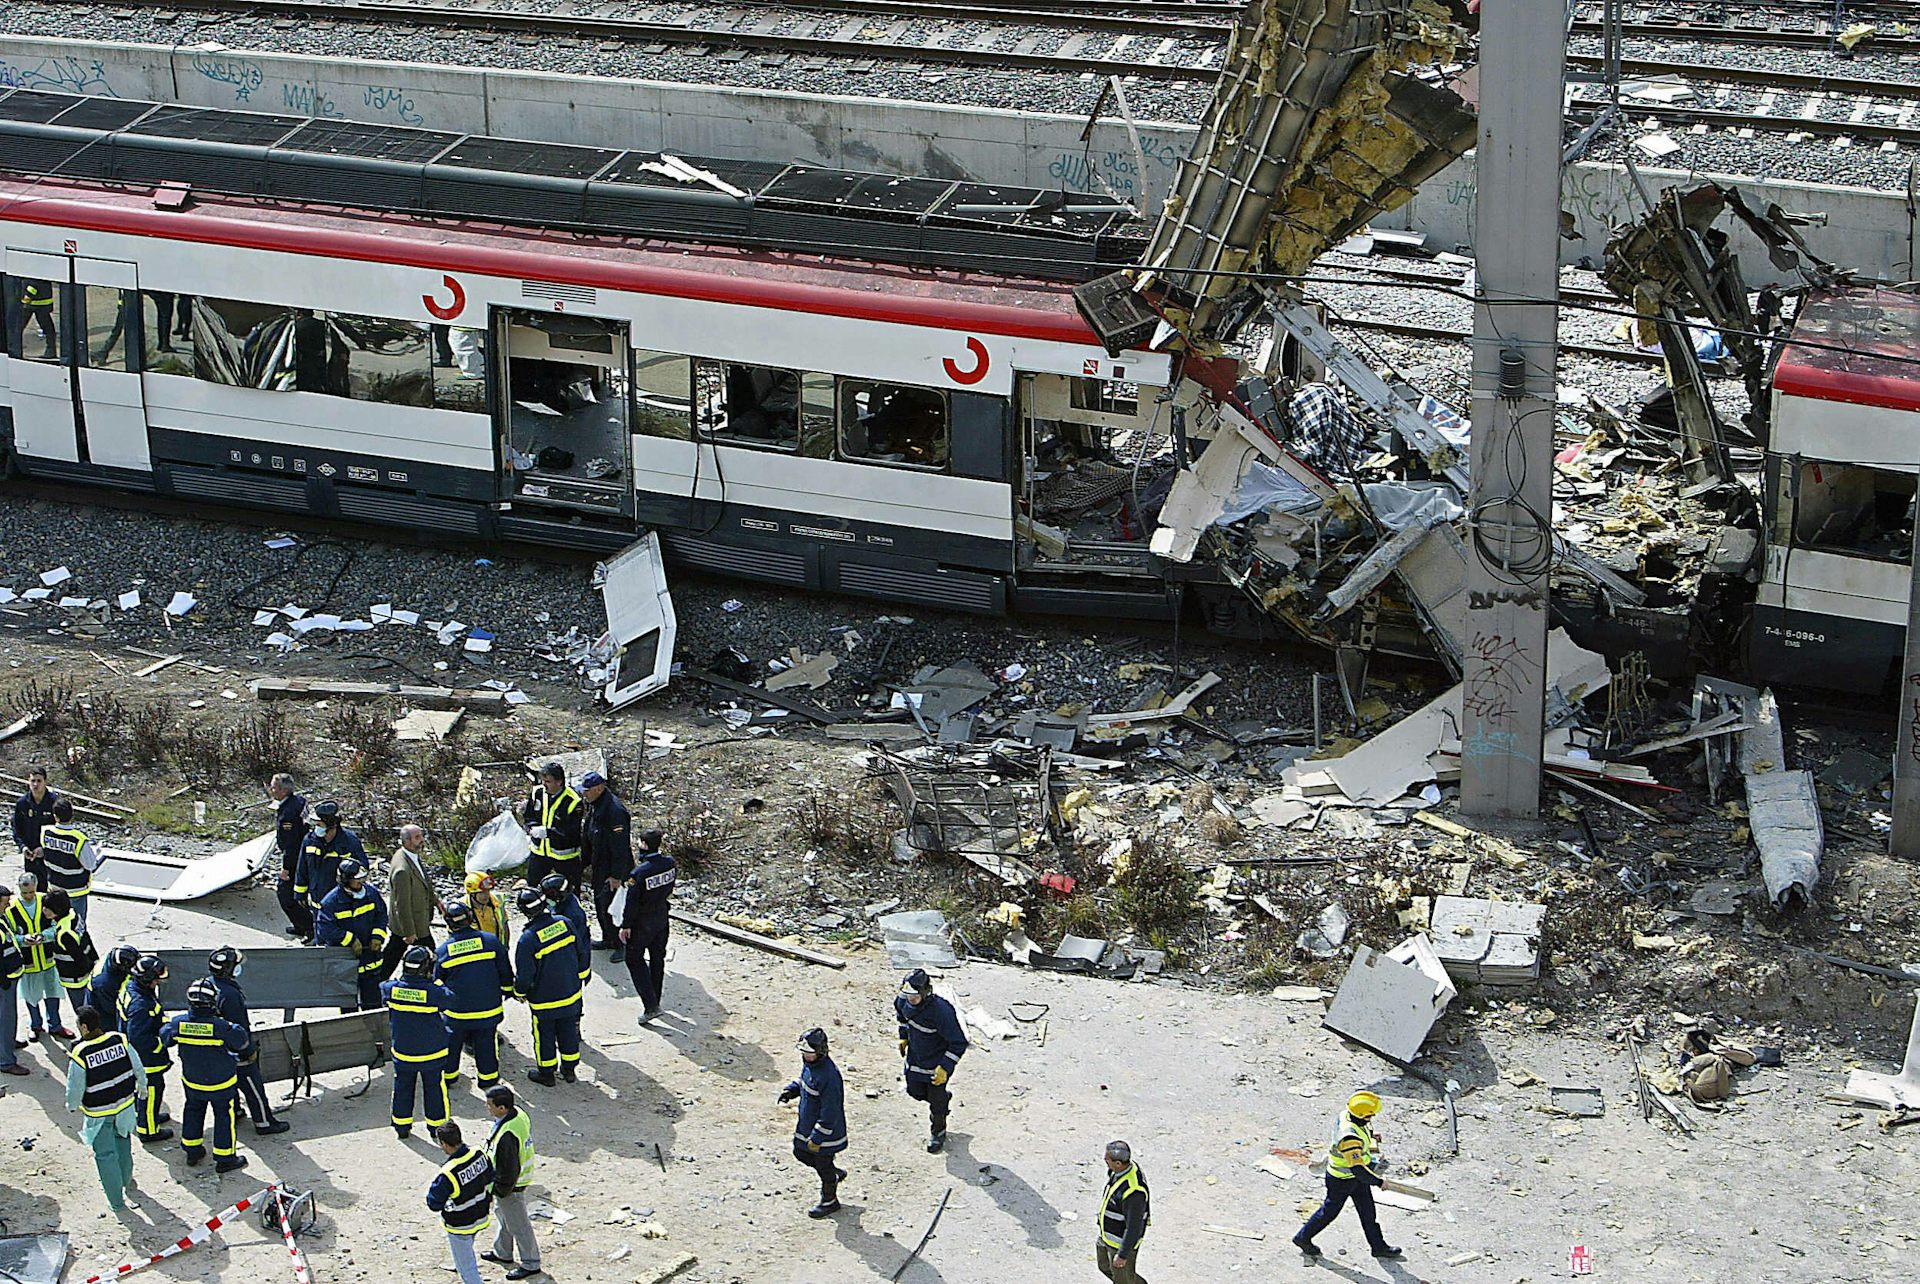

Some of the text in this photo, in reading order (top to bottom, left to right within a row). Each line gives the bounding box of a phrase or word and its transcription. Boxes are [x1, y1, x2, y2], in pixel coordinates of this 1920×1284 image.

[1764, 625, 1825, 643] 7-46-096-0
[44, 837, 76, 854] POLICIA
[87, 1045, 126, 1068] POLICIA
